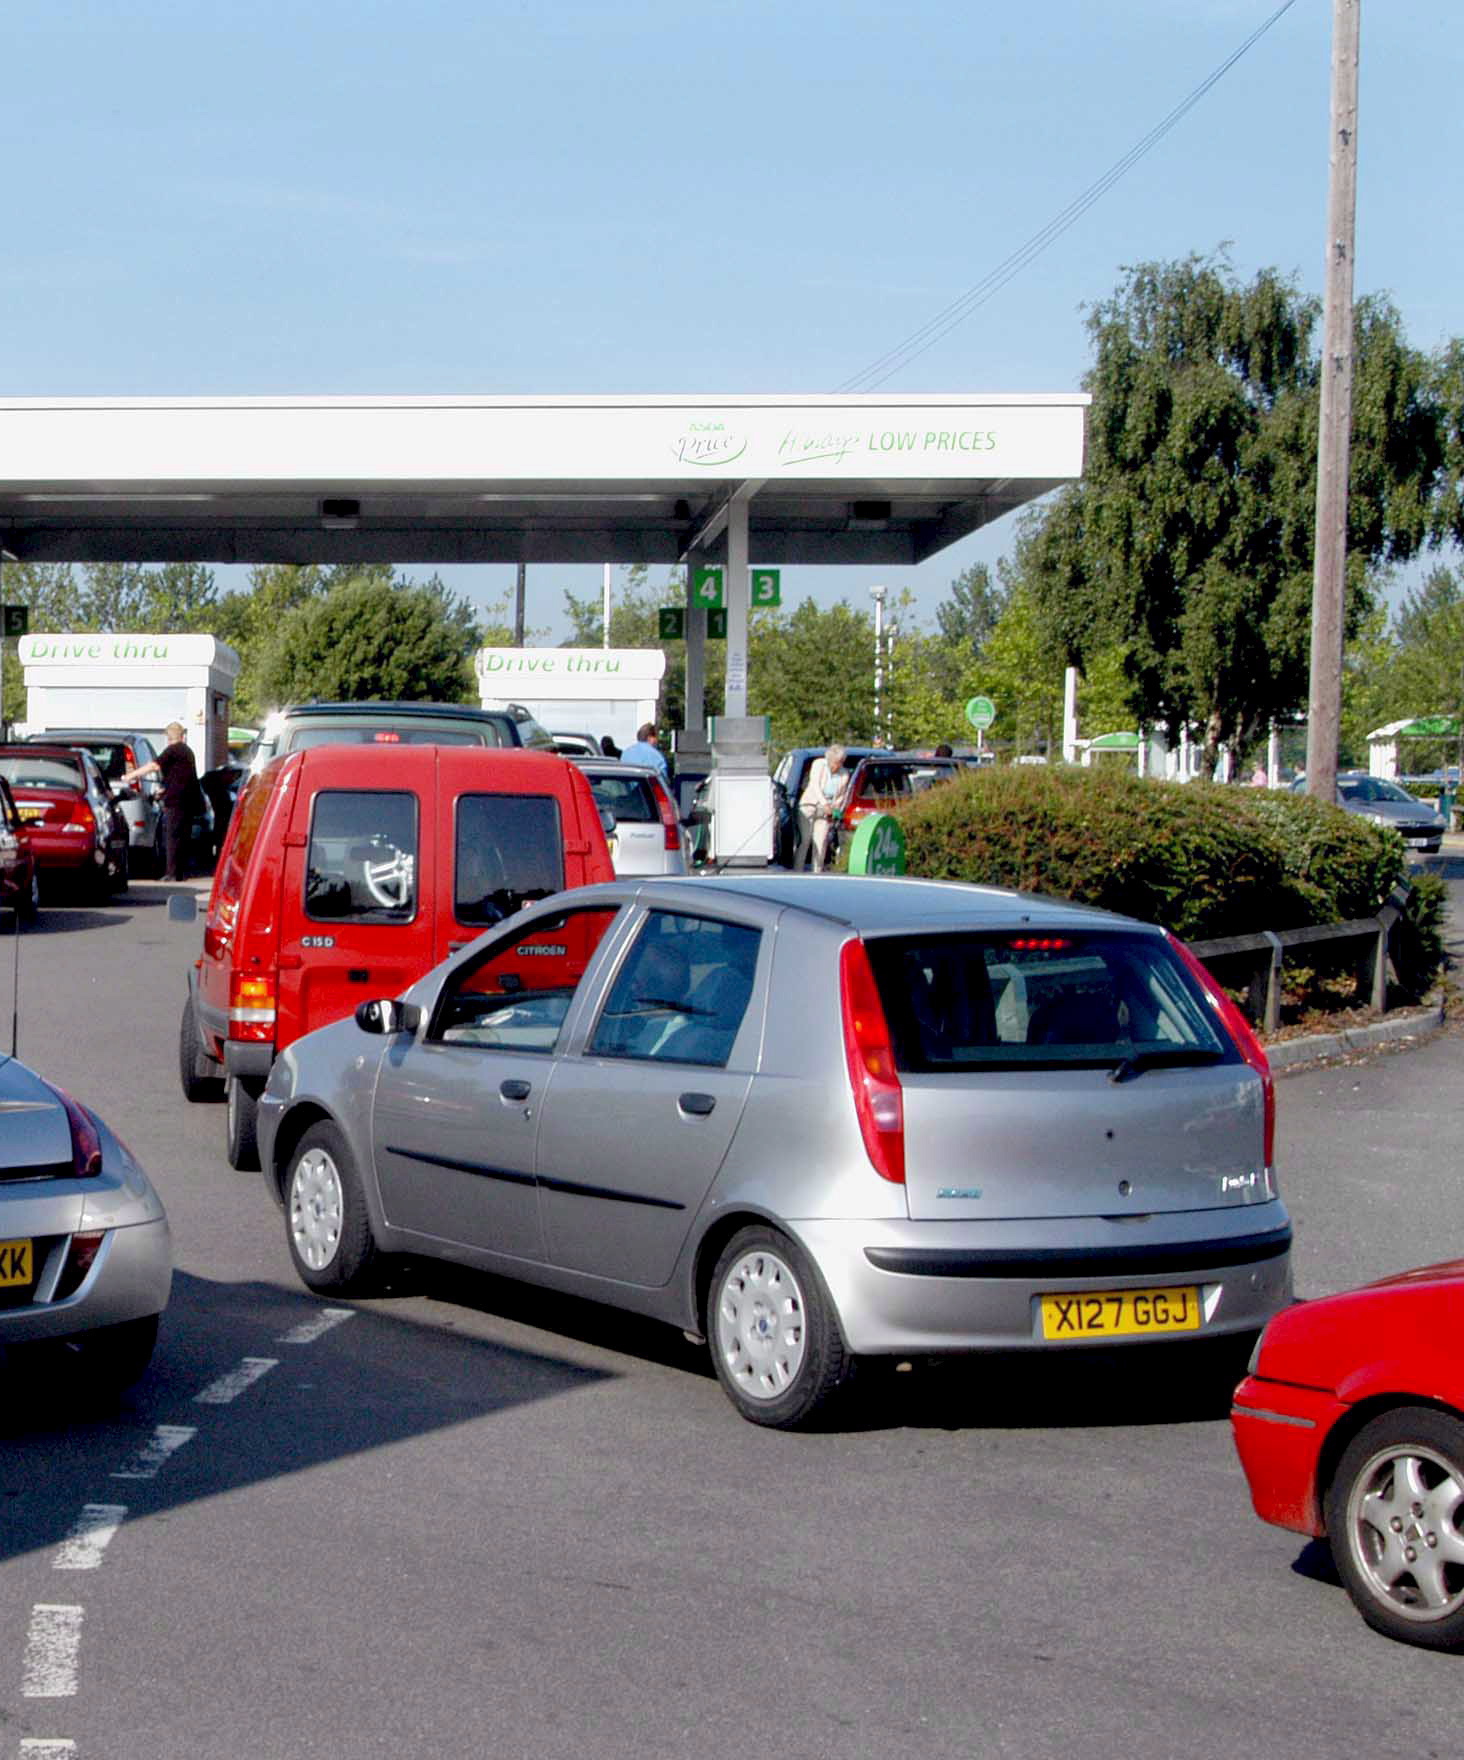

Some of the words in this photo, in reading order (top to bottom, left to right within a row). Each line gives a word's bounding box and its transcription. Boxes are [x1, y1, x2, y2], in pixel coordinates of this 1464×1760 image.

[868, 431, 918, 452] LOW
[923, 431, 997, 452] PRICES
[699, 576, 717, 600] 4
[759, 576, 774, 600] 3
[11, 611, 24, 631] 5
[665, 613, 677, 633] 2
[713, 613, 724, 633] 1
[30, 639, 102, 659] Drive
[113, 639, 169, 659] thru
[486, 654, 555, 672] Drive
[567, 654, 622, 672] thru
[1054, 1296, 1123, 1331] X127
[1134, 1293, 1188, 1326] GGJ
